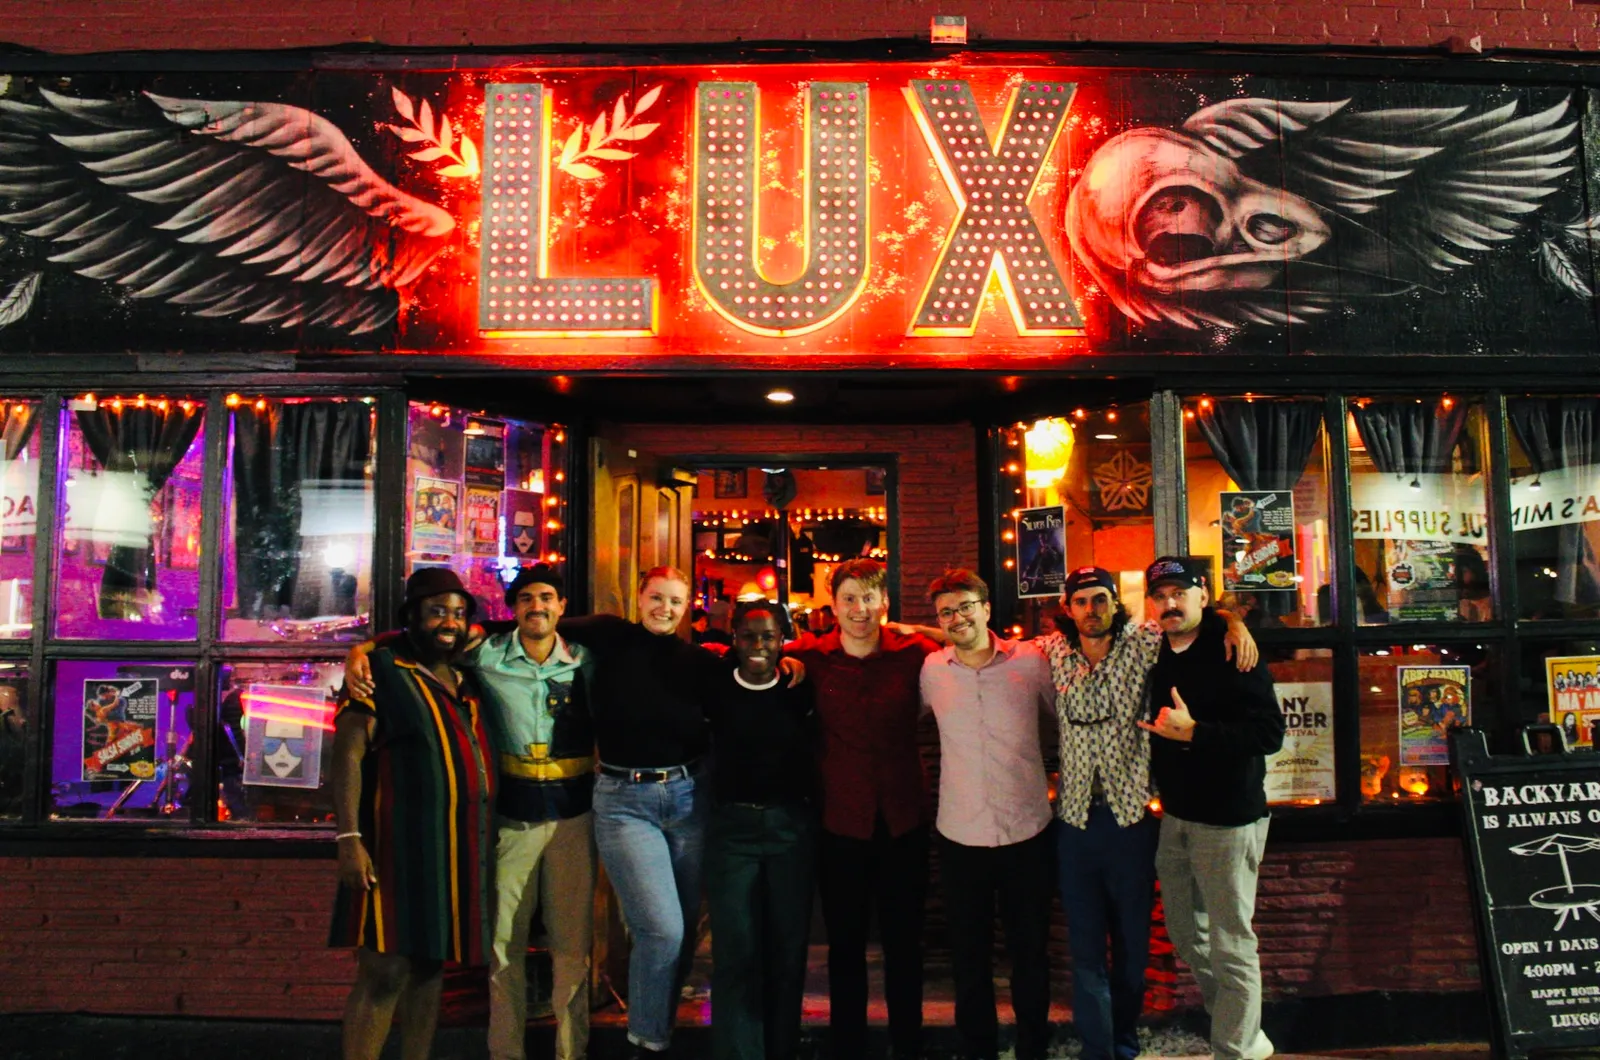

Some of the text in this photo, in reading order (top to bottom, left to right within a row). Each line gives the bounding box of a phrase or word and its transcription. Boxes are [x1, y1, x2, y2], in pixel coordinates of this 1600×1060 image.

[479, 79, 1087, 337] LUX
[1402, 669, 1466, 686] ABBY JEANNE
[1283, 696, 1310, 712] NY
[1283, 712, 1327, 729] DER
[97, 728, 144, 765] SALSA SUNDAYS
[1482, 815, 1500, 829] IS
[1507, 810, 1582, 828] ALWAYS
[1502, 938, 1599, 955] OPEN 7 DAYS
[1523, 963, 1576, 978] 4:00PM
[1531, 988, 1567, 999] HAPPY
[1550, 1012, 1600, 1028] LUX66
